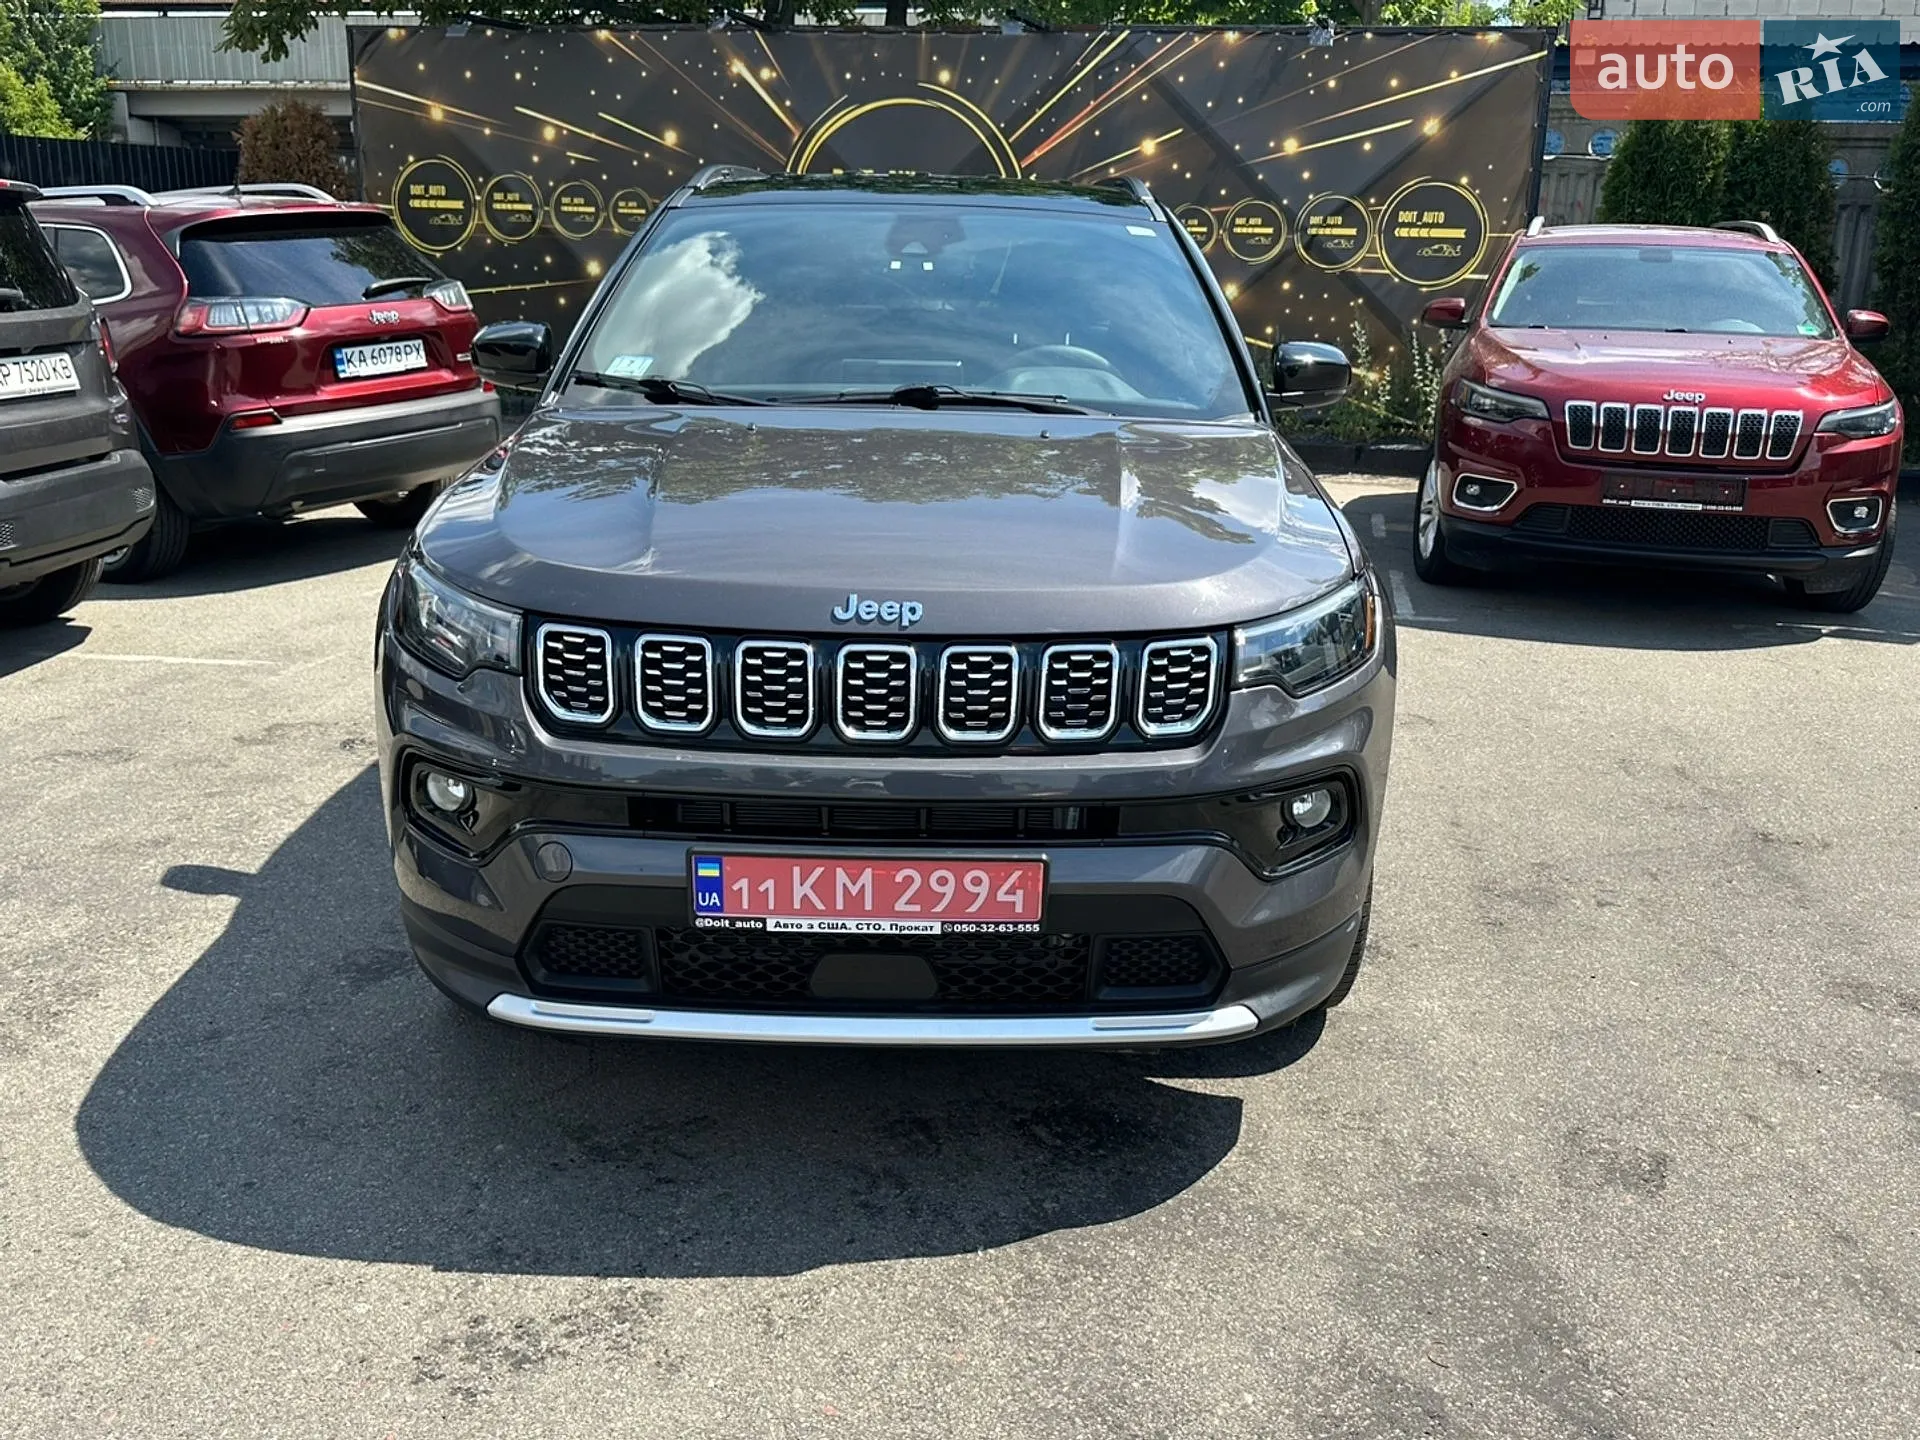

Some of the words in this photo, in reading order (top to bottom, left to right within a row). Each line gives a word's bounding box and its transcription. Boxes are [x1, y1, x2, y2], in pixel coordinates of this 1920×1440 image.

[1398, 211, 1445, 225] DOIT_AUTO
[369, 309, 400, 325] Jeep
[12, 360, 51, 384] 7520
[1662, 389, 1706, 404] Jeep
[833, 593, 923, 626] Jeep
[732, 878, 775, 910] 11
[793, 866, 873, 911] KM
[894, 868, 1024, 913] 2994
[698, 892, 721, 907] UA
[774, 921, 803, 930] Авто
[890, 923, 934, 932] Прокат
[953, 924, 1040, 933] 050-32-63-555
